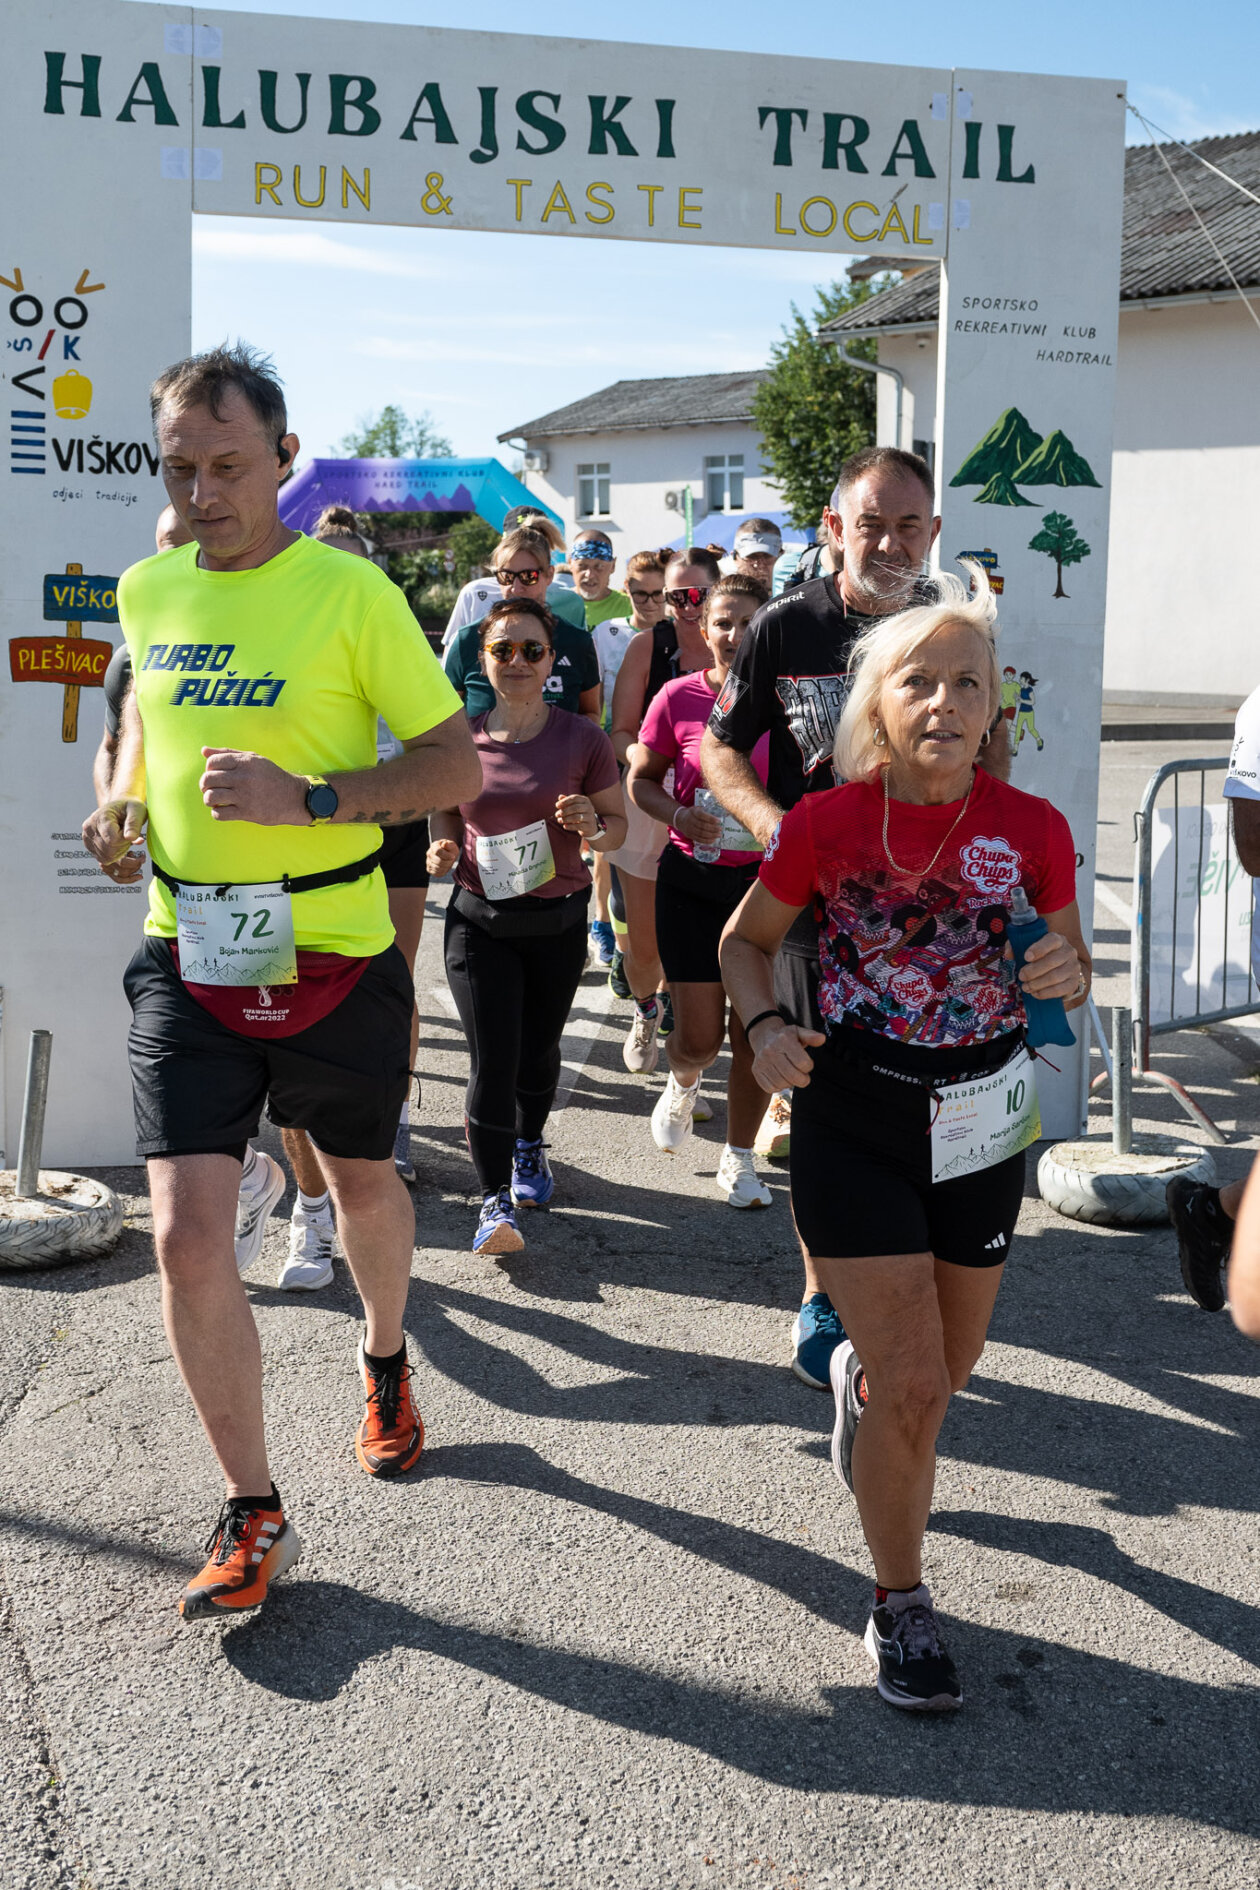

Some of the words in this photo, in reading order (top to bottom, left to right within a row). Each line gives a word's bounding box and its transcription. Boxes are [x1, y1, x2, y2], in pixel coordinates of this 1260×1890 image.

[44, 51, 677, 164] HALUBAJSKI
[758, 106, 1036, 184] TRAIL
[254, 162, 372, 211] RUN
[420, 172, 454, 216] &
[506, 179, 703, 229] TASTE
[962, 297, 1039, 311] SPORTSKO
[954, 320, 1047, 337] REKREATIVNI
[1063, 326, 1097, 339] KLUB
[1036, 350, 1112, 366] HARDTRAIL
[408, 480, 438, 488] TRAIL
[458, 469, 485, 478] KLUB
[96, 489, 138, 506] tradicije
[18, 643, 105, 674] PLEŠIVAC
[141, 644, 236, 672] TURBO
[514, 841, 538, 866] 77
[968, 846, 1015, 865] Chupa
[967, 861, 1013, 887] Chups
[230, 908, 274, 942] 72
[219, 946, 240, 957] Bojan
[241, 945, 280, 955] Marković
[945, 1074, 1008, 1101] ALUBAJSKI
[1006, 1079, 1025, 1116] 10
